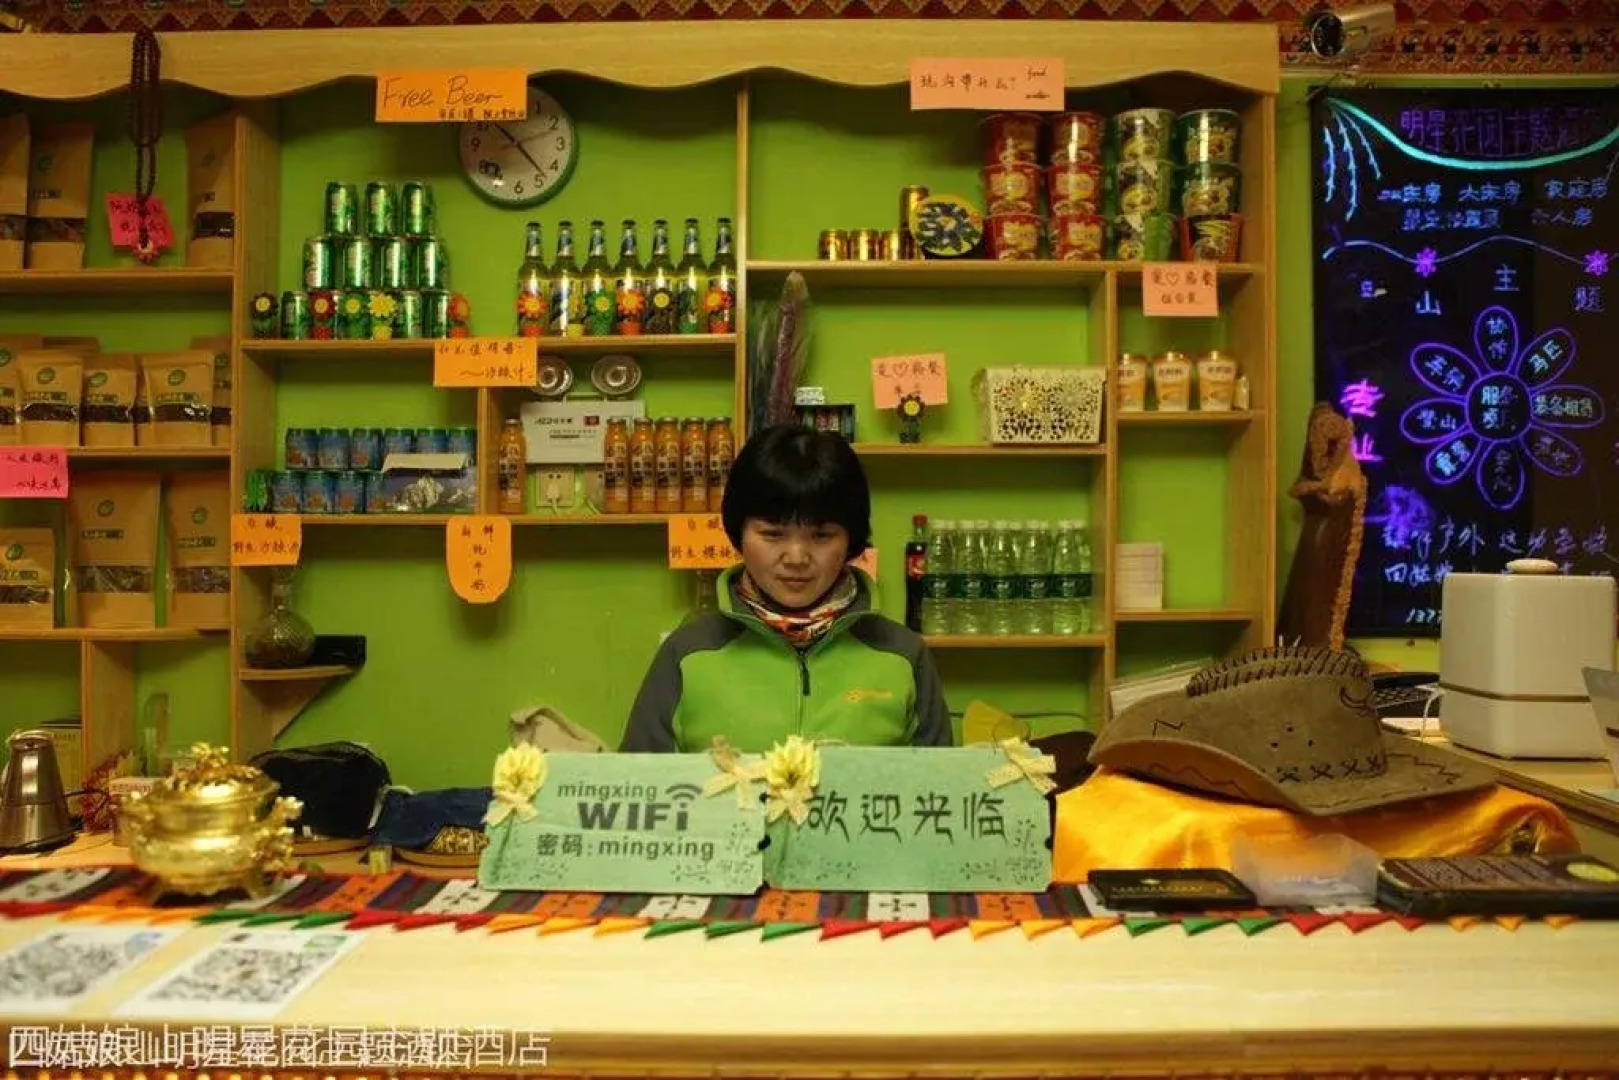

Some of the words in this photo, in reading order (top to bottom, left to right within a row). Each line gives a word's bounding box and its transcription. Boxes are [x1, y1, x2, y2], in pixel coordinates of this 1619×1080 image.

[383, 76, 434, 108] Free
[446, 75, 502, 105] Beer
[549, 115, 559, 131] 2
[470, 138, 481, 152] 9
[556, 137, 565, 151] 3
[550, 159, 559, 172] 4
[513, 180, 524, 194] 6
[534, 173, 545, 188] 5
[1415, 290, 1442, 315] 山
[557, 781, 658, 801] mingxing
[577, 802, 689, 831] WIFi
[802, 790, 1008, 844] 欢迎光临
